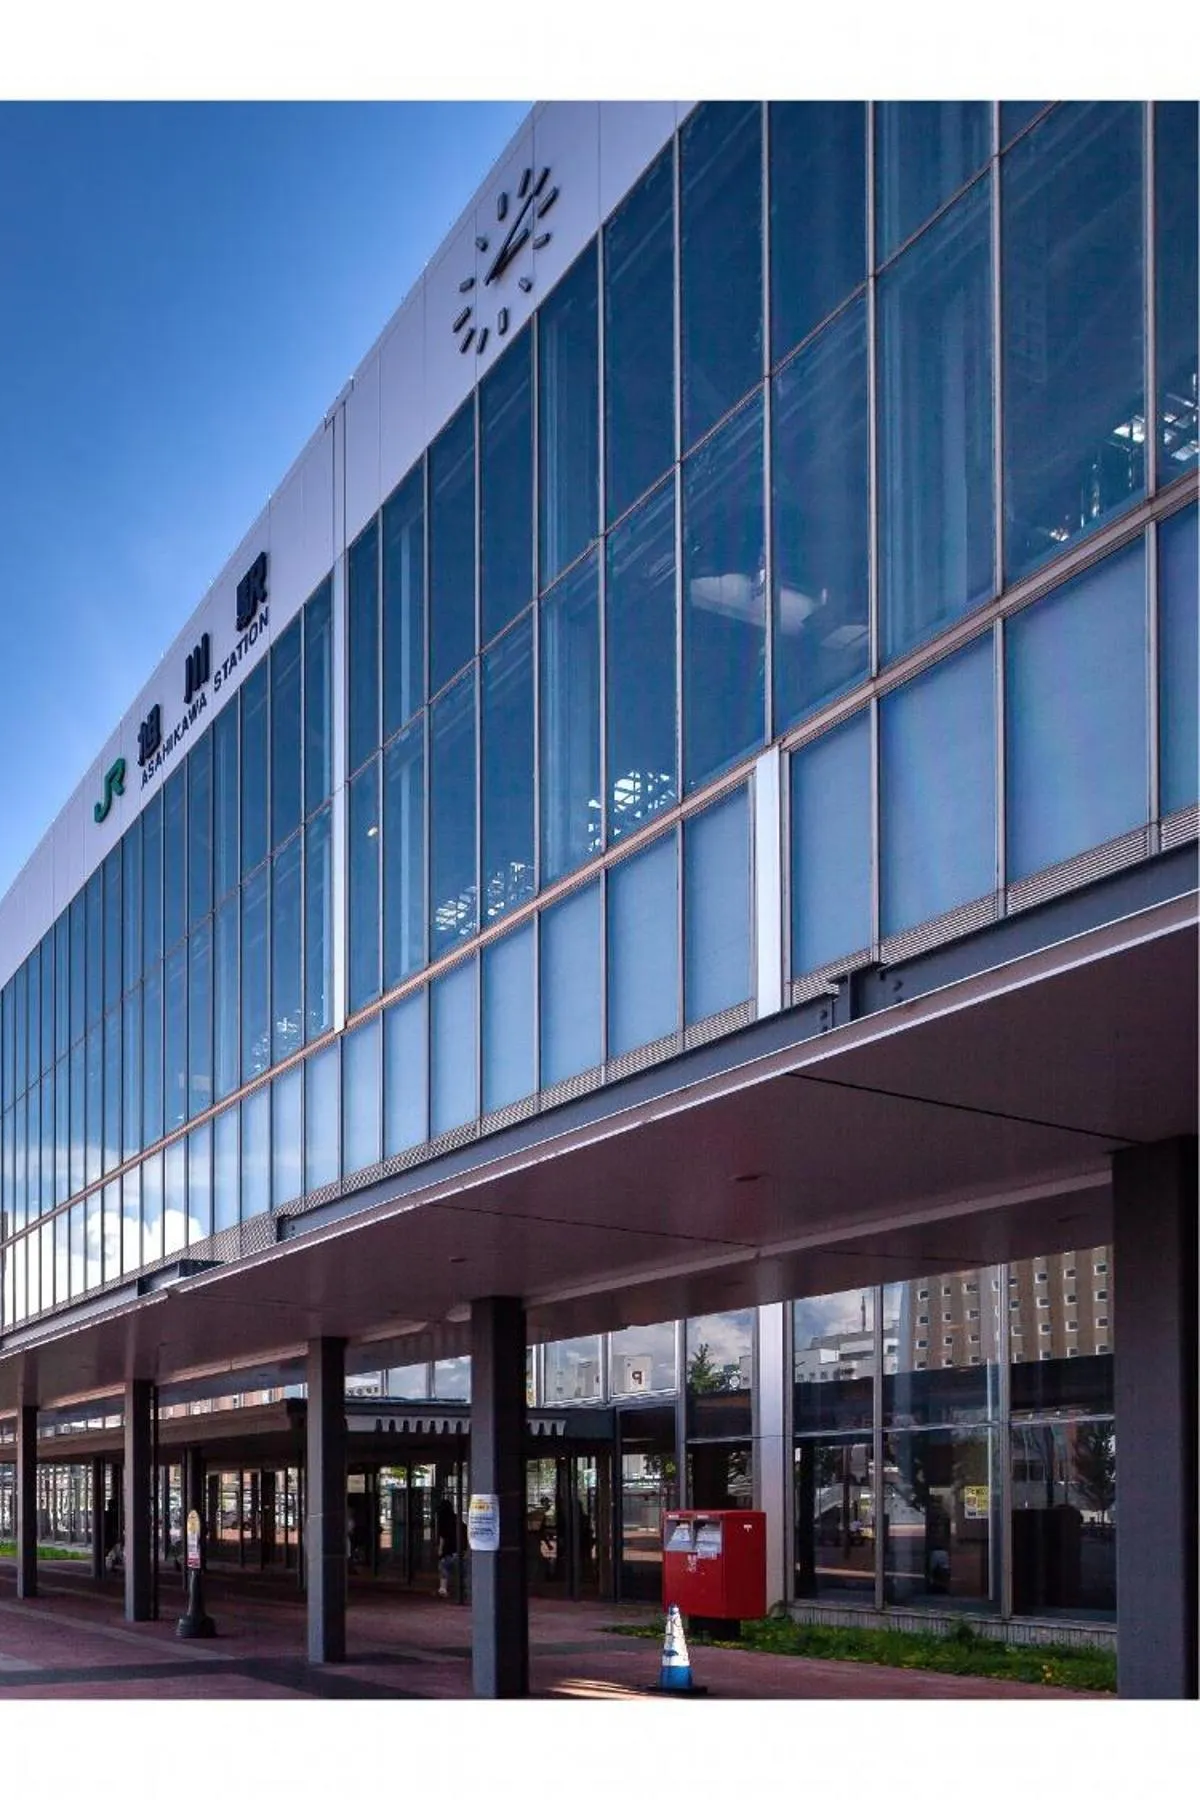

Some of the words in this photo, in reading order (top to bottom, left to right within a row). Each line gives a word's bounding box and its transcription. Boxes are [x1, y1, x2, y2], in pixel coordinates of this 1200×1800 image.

[140, 692, 208, 791] ASAHIKAWA
[213, 606, 269, 693] STATION
[94, 758, 126, 823] JR
